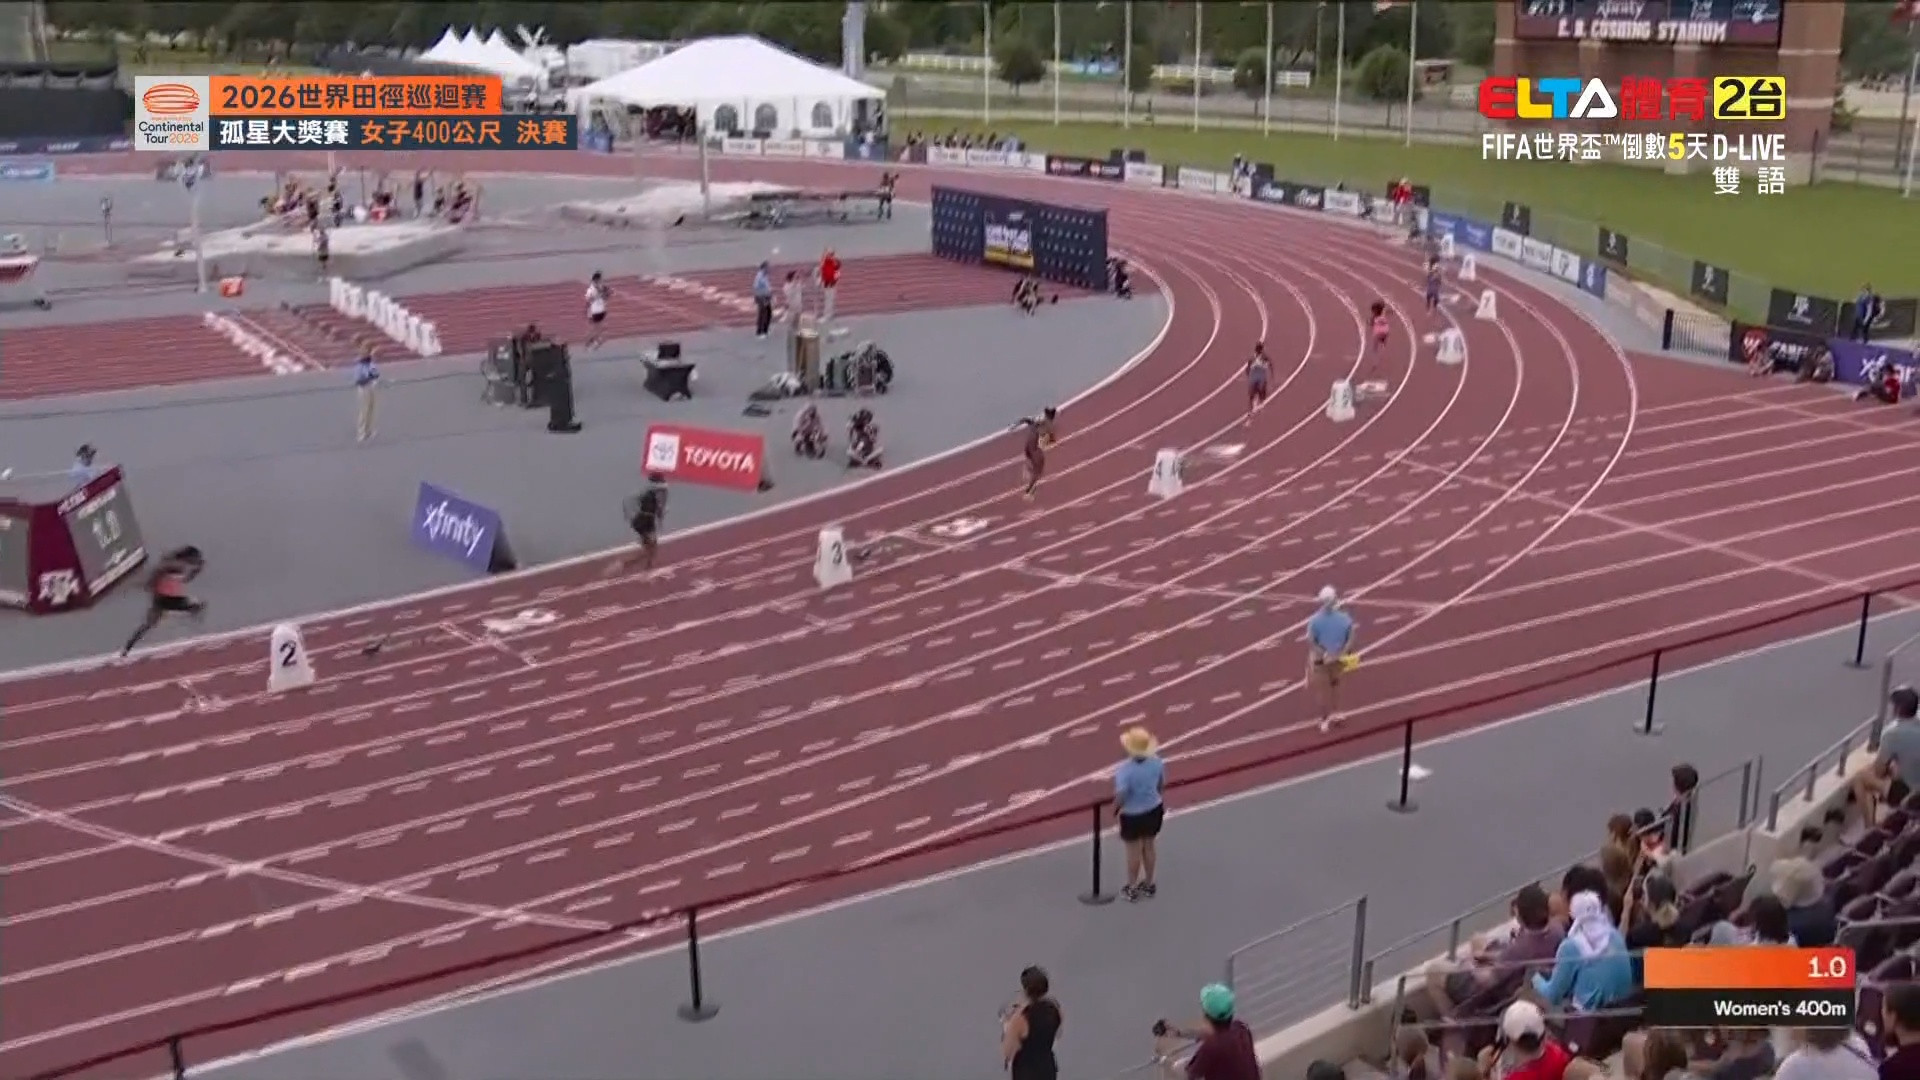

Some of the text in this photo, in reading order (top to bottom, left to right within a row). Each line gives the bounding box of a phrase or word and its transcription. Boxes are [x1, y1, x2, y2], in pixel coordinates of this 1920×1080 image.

[684, 445, 755, 473] TOYOTA
[423, 500, 485, 557] xfinity
[831, 541, 843, 566] 3
[279, 640, 298, 667] 2
